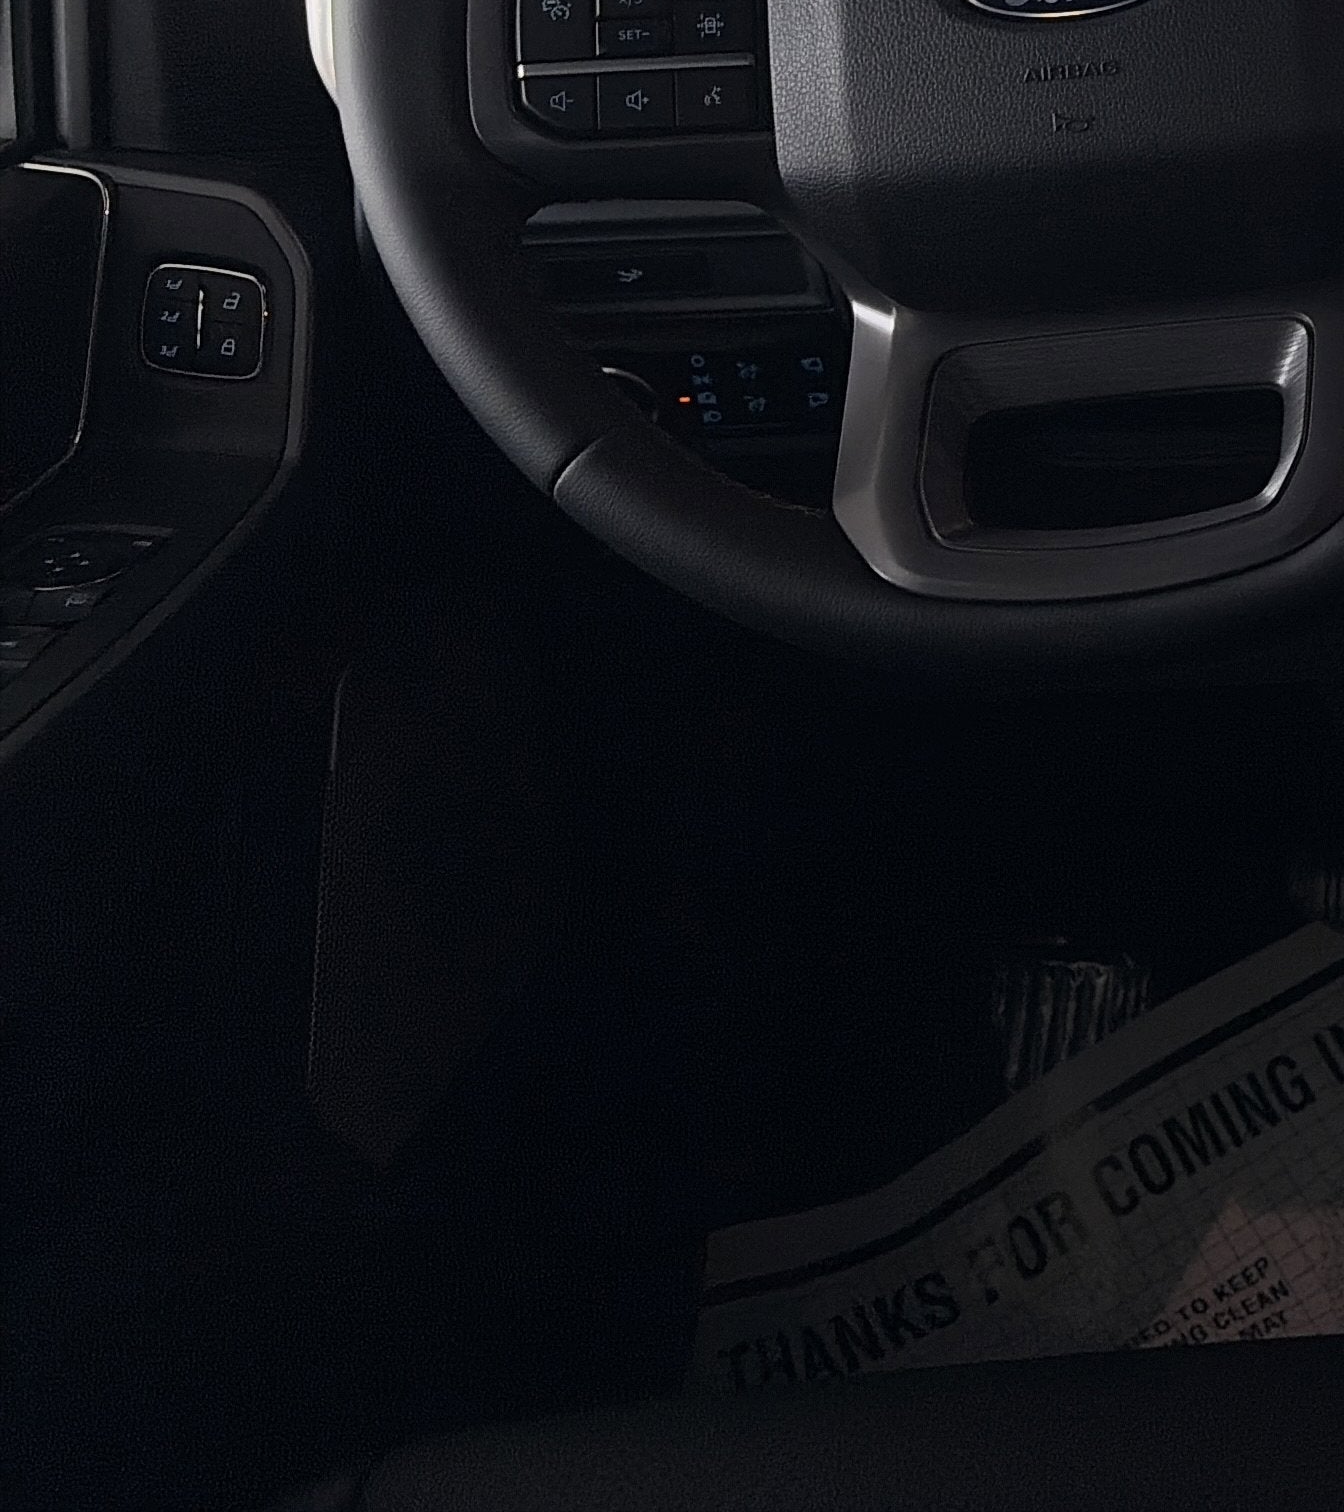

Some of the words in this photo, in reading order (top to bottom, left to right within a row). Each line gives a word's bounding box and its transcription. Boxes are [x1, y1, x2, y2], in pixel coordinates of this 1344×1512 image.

[717, 1272, 961, 1391] THANKS
[1093, 1055, 1316, 1217] COMING
[1176, 1297, 1208, 1320] TO
[1213, 1257, 1268, 1301] KEEP
[1214, 1280, 1289, 1329] CLEAN
